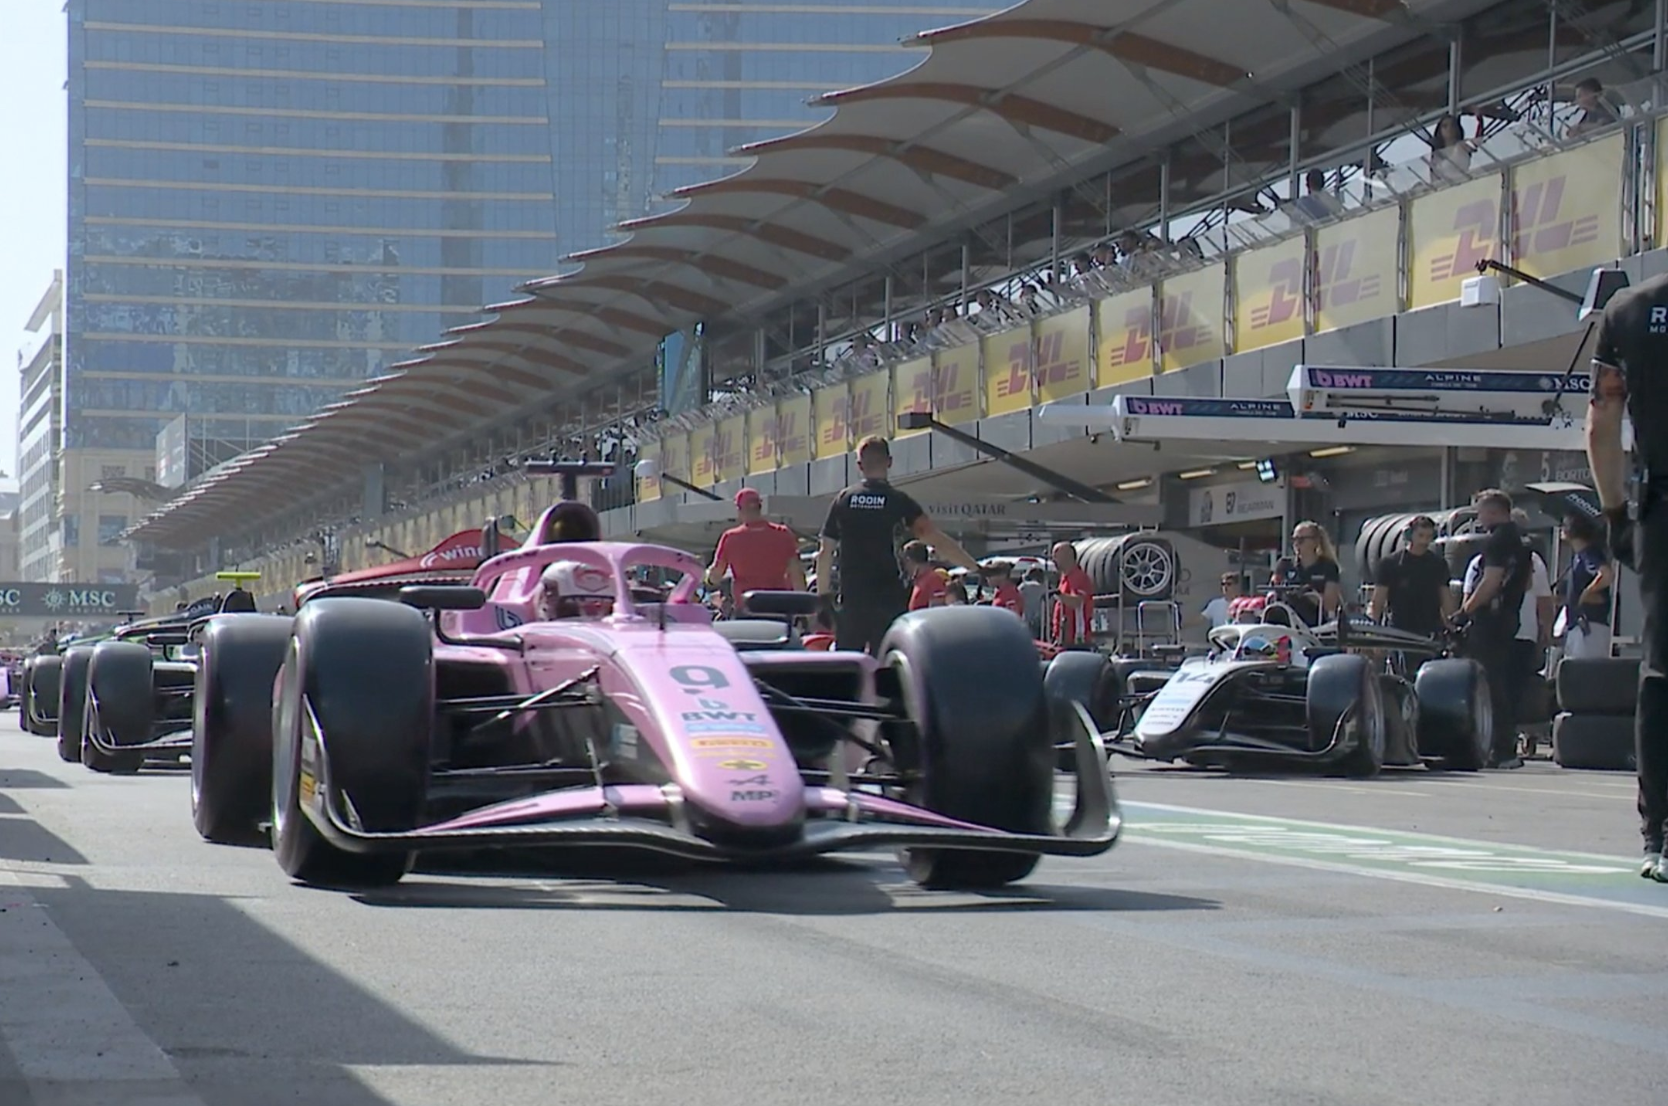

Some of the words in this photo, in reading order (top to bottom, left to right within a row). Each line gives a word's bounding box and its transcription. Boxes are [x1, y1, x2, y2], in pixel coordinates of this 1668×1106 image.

[1333, 373, 1372, 387] BWT
[1425, 374, 1482, 382] ALPINE
[1149, 402, 1184, 415] BWT
[1229, 403, 1281, 411] ALPINE
[850, 495, 885, 505] RODIN
[928, 504, 957, 515] visit
[961, 503, 1006, 515] QATAR
[69, 590, 116, 607] MSC
[669, 665, 730, 694] 9
[1176, 672, 1216, 684] 14
[681, 711, 756, 721] BWT
